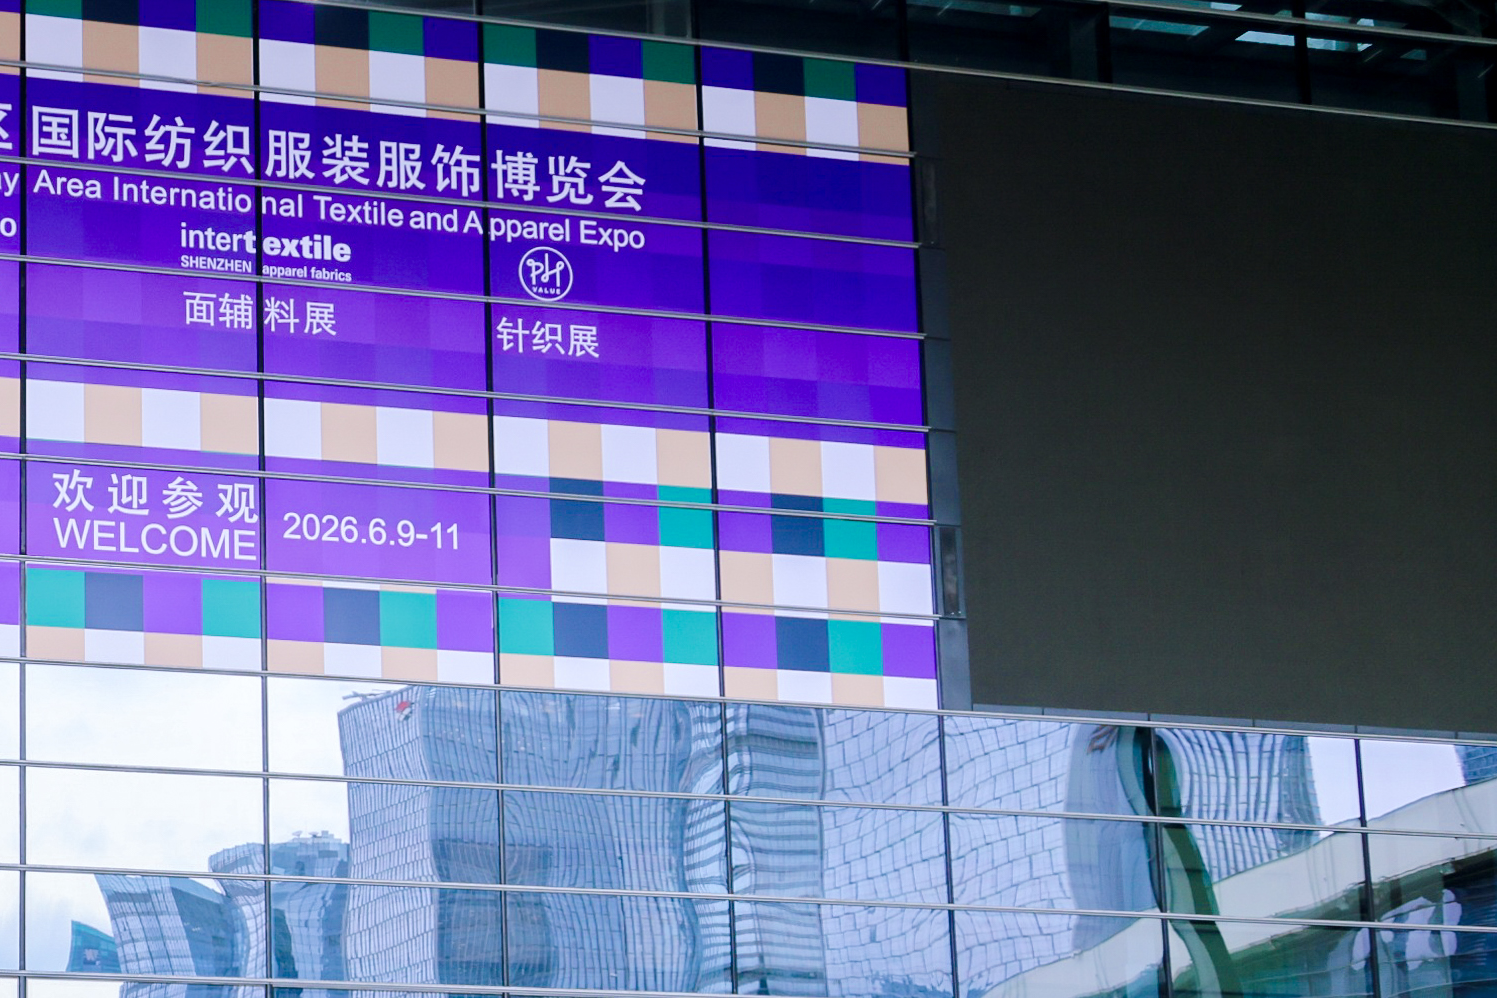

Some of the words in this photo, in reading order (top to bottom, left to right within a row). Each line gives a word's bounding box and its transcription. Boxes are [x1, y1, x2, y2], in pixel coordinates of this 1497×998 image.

[33, 169, 102, 200] Area
[113, 176, 303, 218] International
[313, 195, 404, 228] Textile
[409, 206, 459, 232] and
[463, 211, 571, 243] Apparel
[579, 220, 645, 252] Expo
[180, 223, 352, 262] intertextile
[180, 255, 252, 273] SHENZHEN
[262, 263, 308, 280] apparel
[310, 266, 352, 282] fabrics
[532, 286, 561, 295] VALUE
[183, 290, 337, 336] 面辅料展
[496, 316, 600, 358] 针织展
[52, 468, 259, 524] 欢迎参观
[53, 517, 258, 561] WELCOME
[282, 512, 459, 550] 2026.6.9-11
